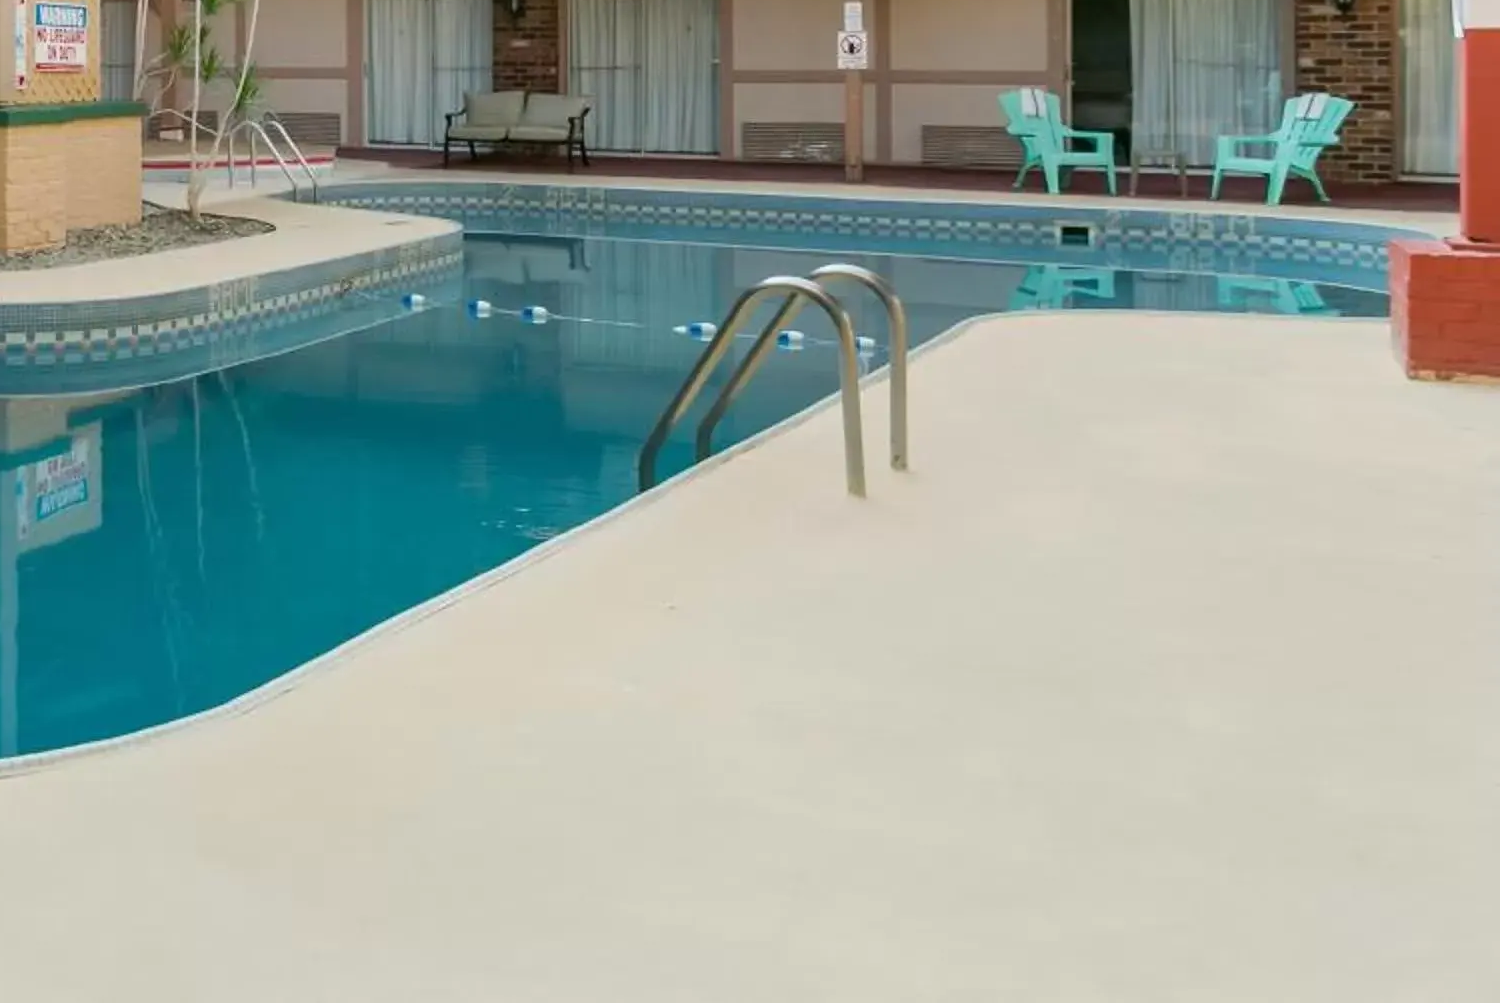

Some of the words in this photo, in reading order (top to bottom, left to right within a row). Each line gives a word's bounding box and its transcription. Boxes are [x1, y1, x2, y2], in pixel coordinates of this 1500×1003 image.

[39, 5, 85, 27] WARNING
[37, 28, 47, 43] NO
[49, 28, 84, 44] LIFEGUARD
[47, 44, 57, 60] ON
[59, 45, 77, 61] DUTY
